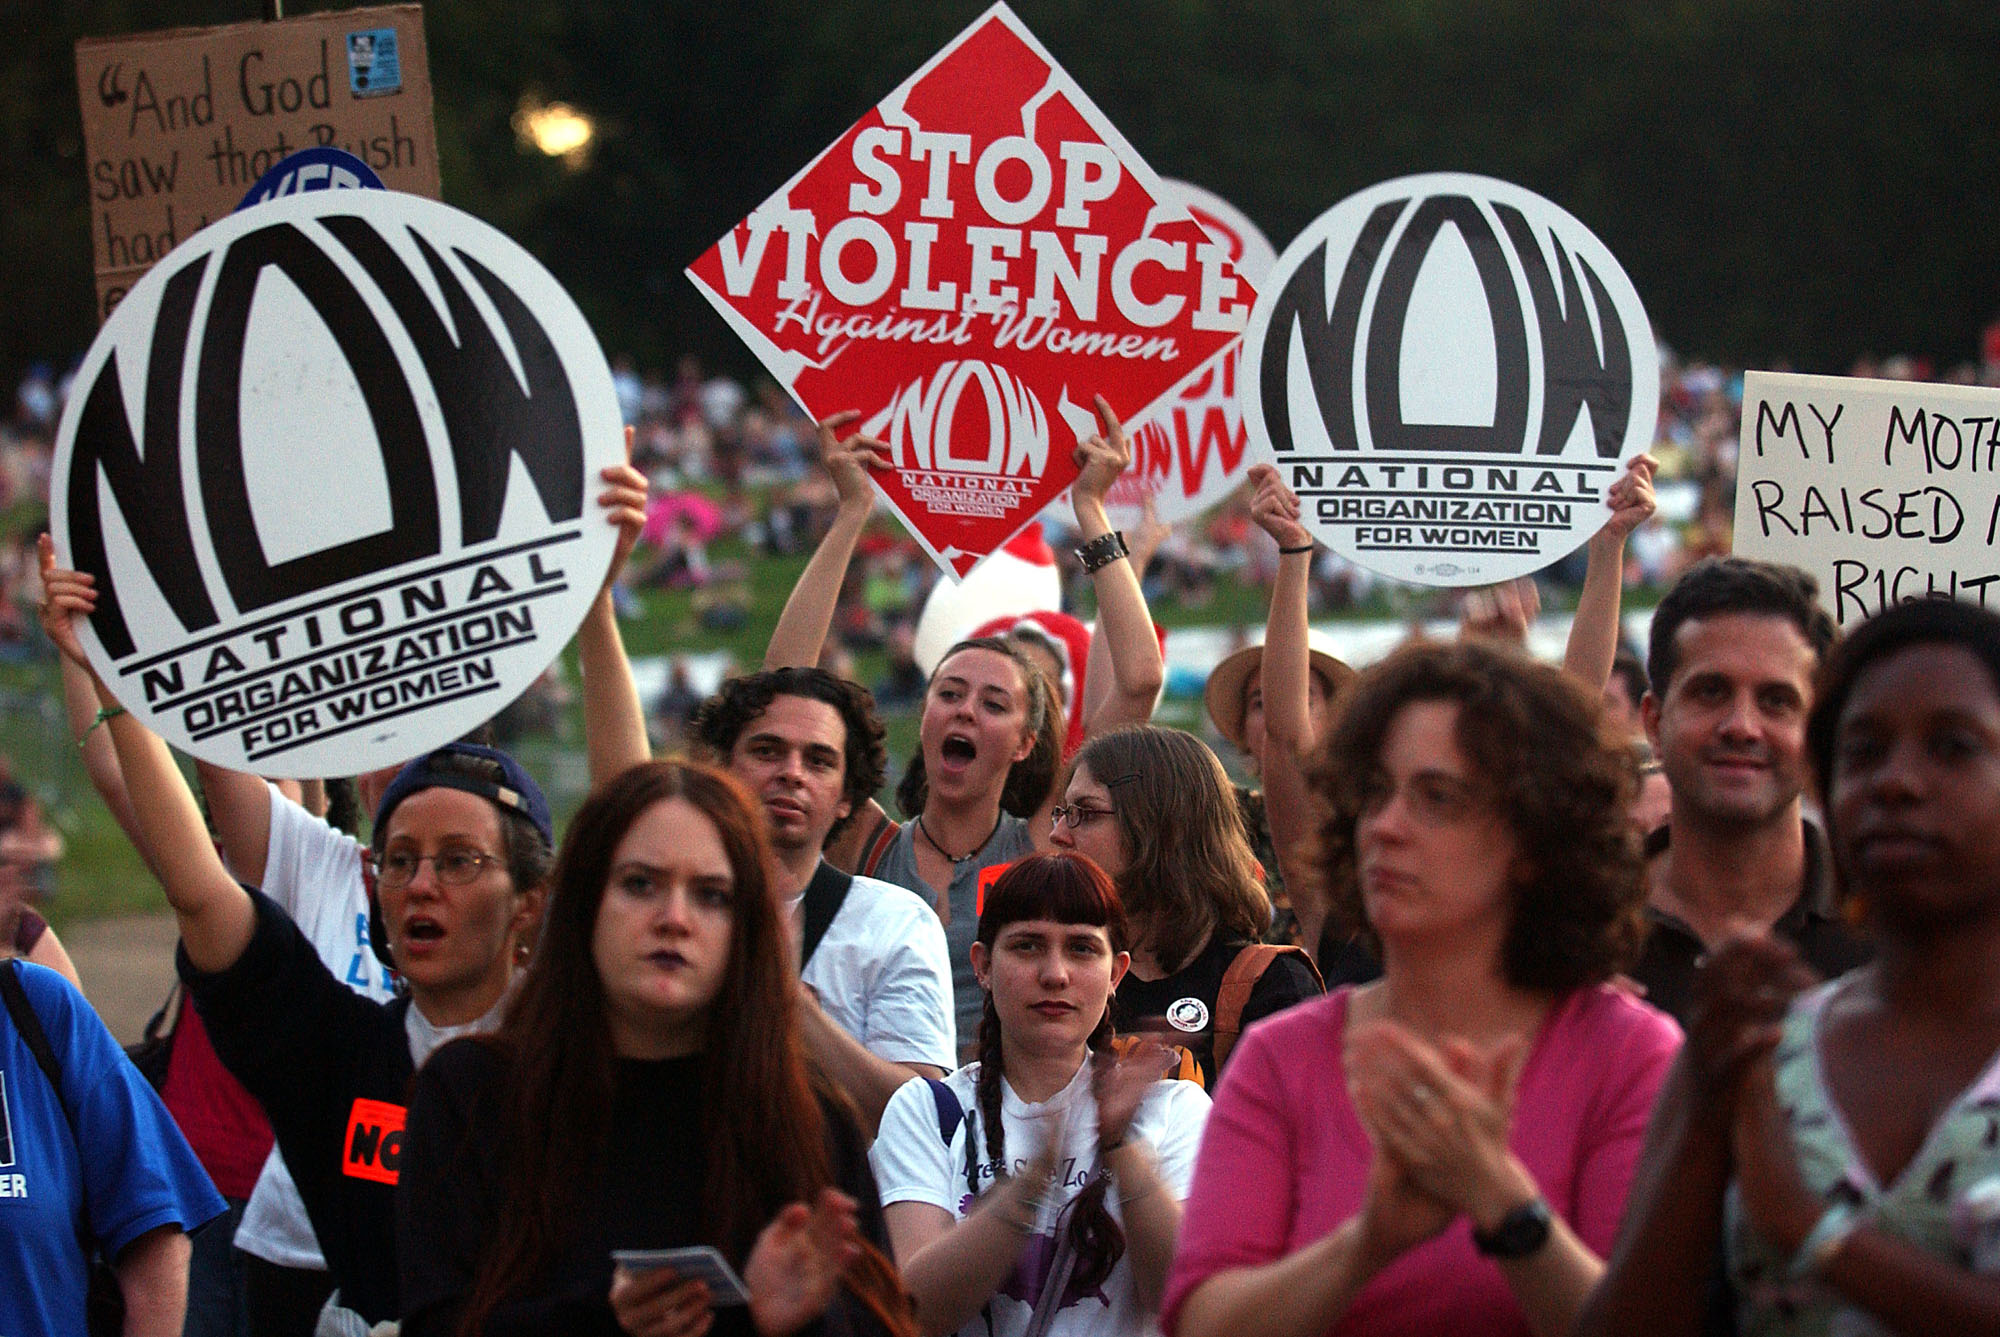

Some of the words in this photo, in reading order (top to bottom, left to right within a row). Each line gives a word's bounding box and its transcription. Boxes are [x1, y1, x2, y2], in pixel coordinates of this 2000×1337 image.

[239, 38, 332, 118] God
[94, 152, 178, 201] saw
[848, 125, 1121, 229] STOP
[717, 207, 1249, 333] VIOLENCE
[773, 289, 973, 356] Against
[992, 301, 1180, 362] Women
[1260, 194, 1633, 459] NOW
[68, 213, 586, 661] NOW
[890, 359, 1050, 478] NOW
[1756, 399, 1844, 464] MY
[902, 473, 1032, 494] NATIONAL
[911, 487, 1020, 508] ORGANIZATION
[1292, 465, 1600, 495] NATIONAL
[1316, 498, 1572, 524] ORGANIZATION
[1751, 479, 1965, 544] RAISED
[1355, 526, 1413, 545] FOR
[1420, 528, 1539, 547] WOMEN
[142, 553, 565, 702] NATIONAL
[183, 605, 535, 734] ORGANIZATION
[241, 709, 320, 751] FOR
[327, 657, 495, 722] WOMEN
